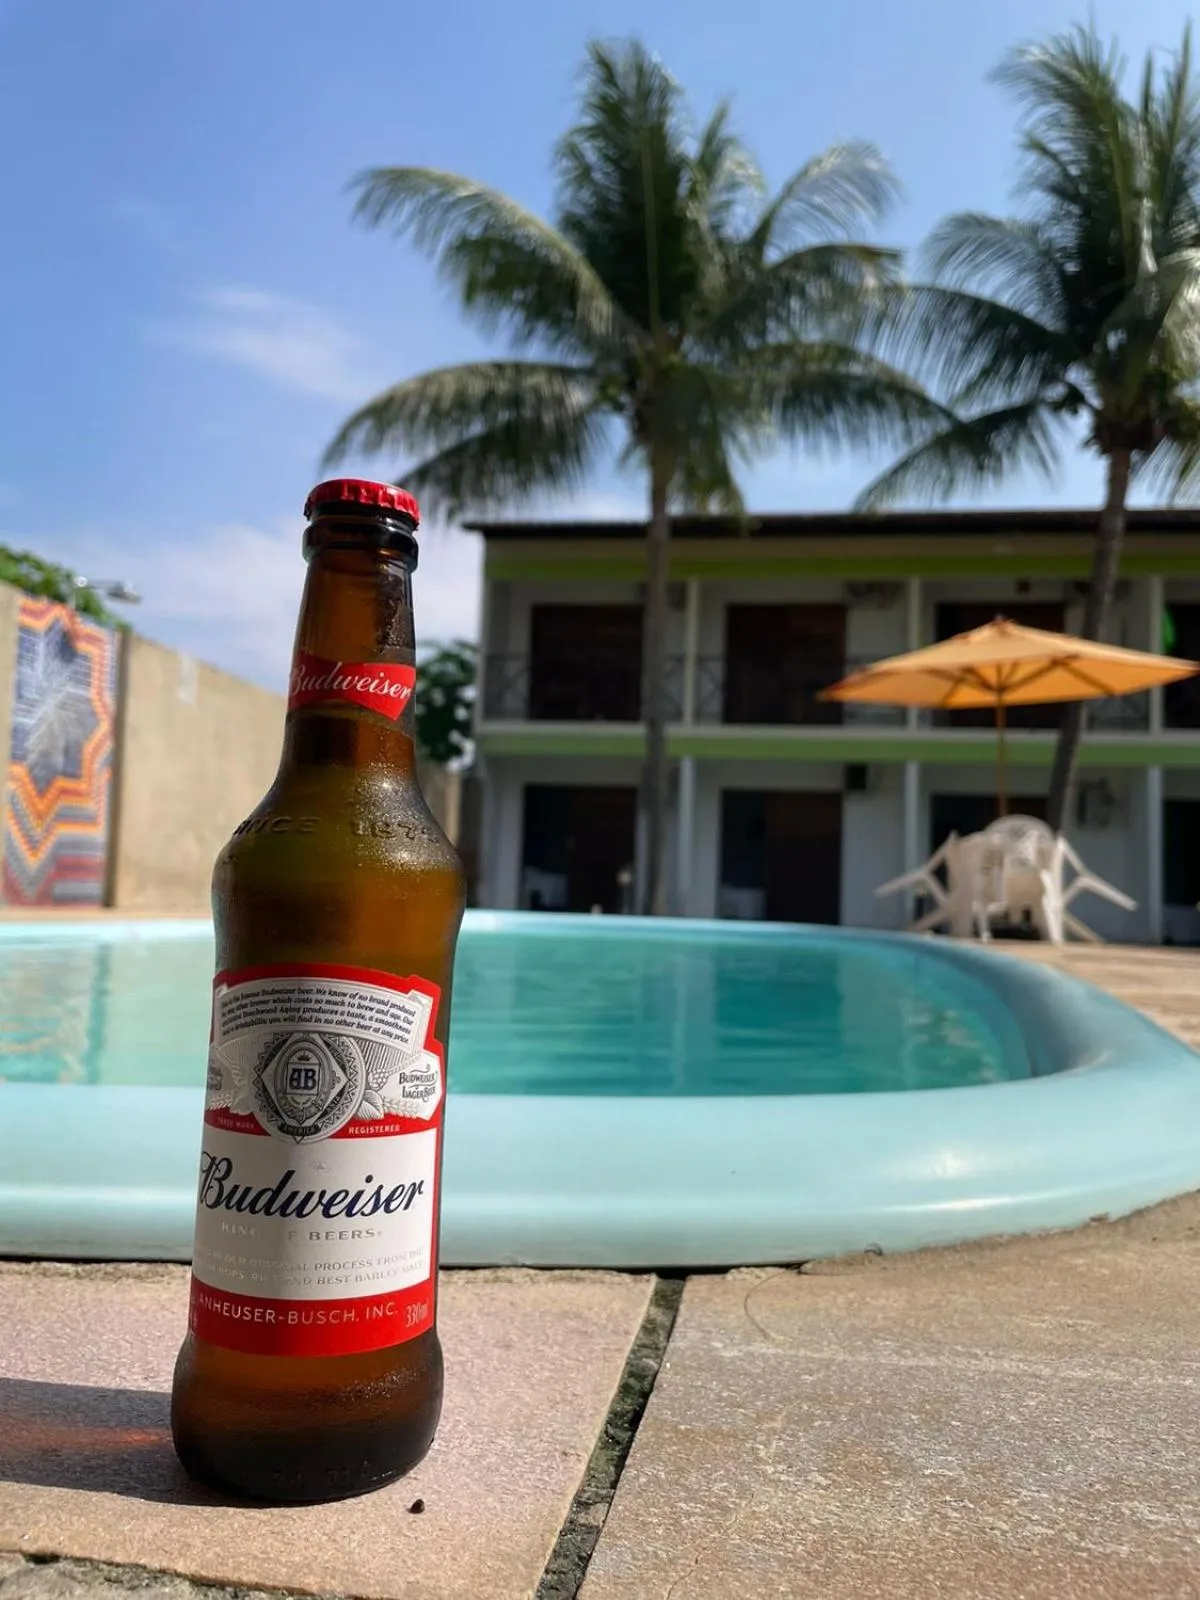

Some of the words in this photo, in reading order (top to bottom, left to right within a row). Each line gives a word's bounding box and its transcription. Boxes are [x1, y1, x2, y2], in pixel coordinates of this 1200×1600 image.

[290, 661, 412, 699] Budweiser
[328, 987, 348, 998] know
[349, 991, 359, 1001] of
[368, 995, 390, 1007] brand
[324, 998, 346, 1007] much
[347, 1001, 356, 1009] to
[356, 1002, 375, 1012] brew
[375, 1007, 390, 1016] and
[402, 1015, 414, 1026] Our
[335, 1018, 356, 1028] other
[356, 1021, 373, 1031] beer
[348, 1124, 401, 1135] REGISTERED
[200, 1150, 424, 1219] Budweiser
[313, 1259, 373, 1272] PROCESS
